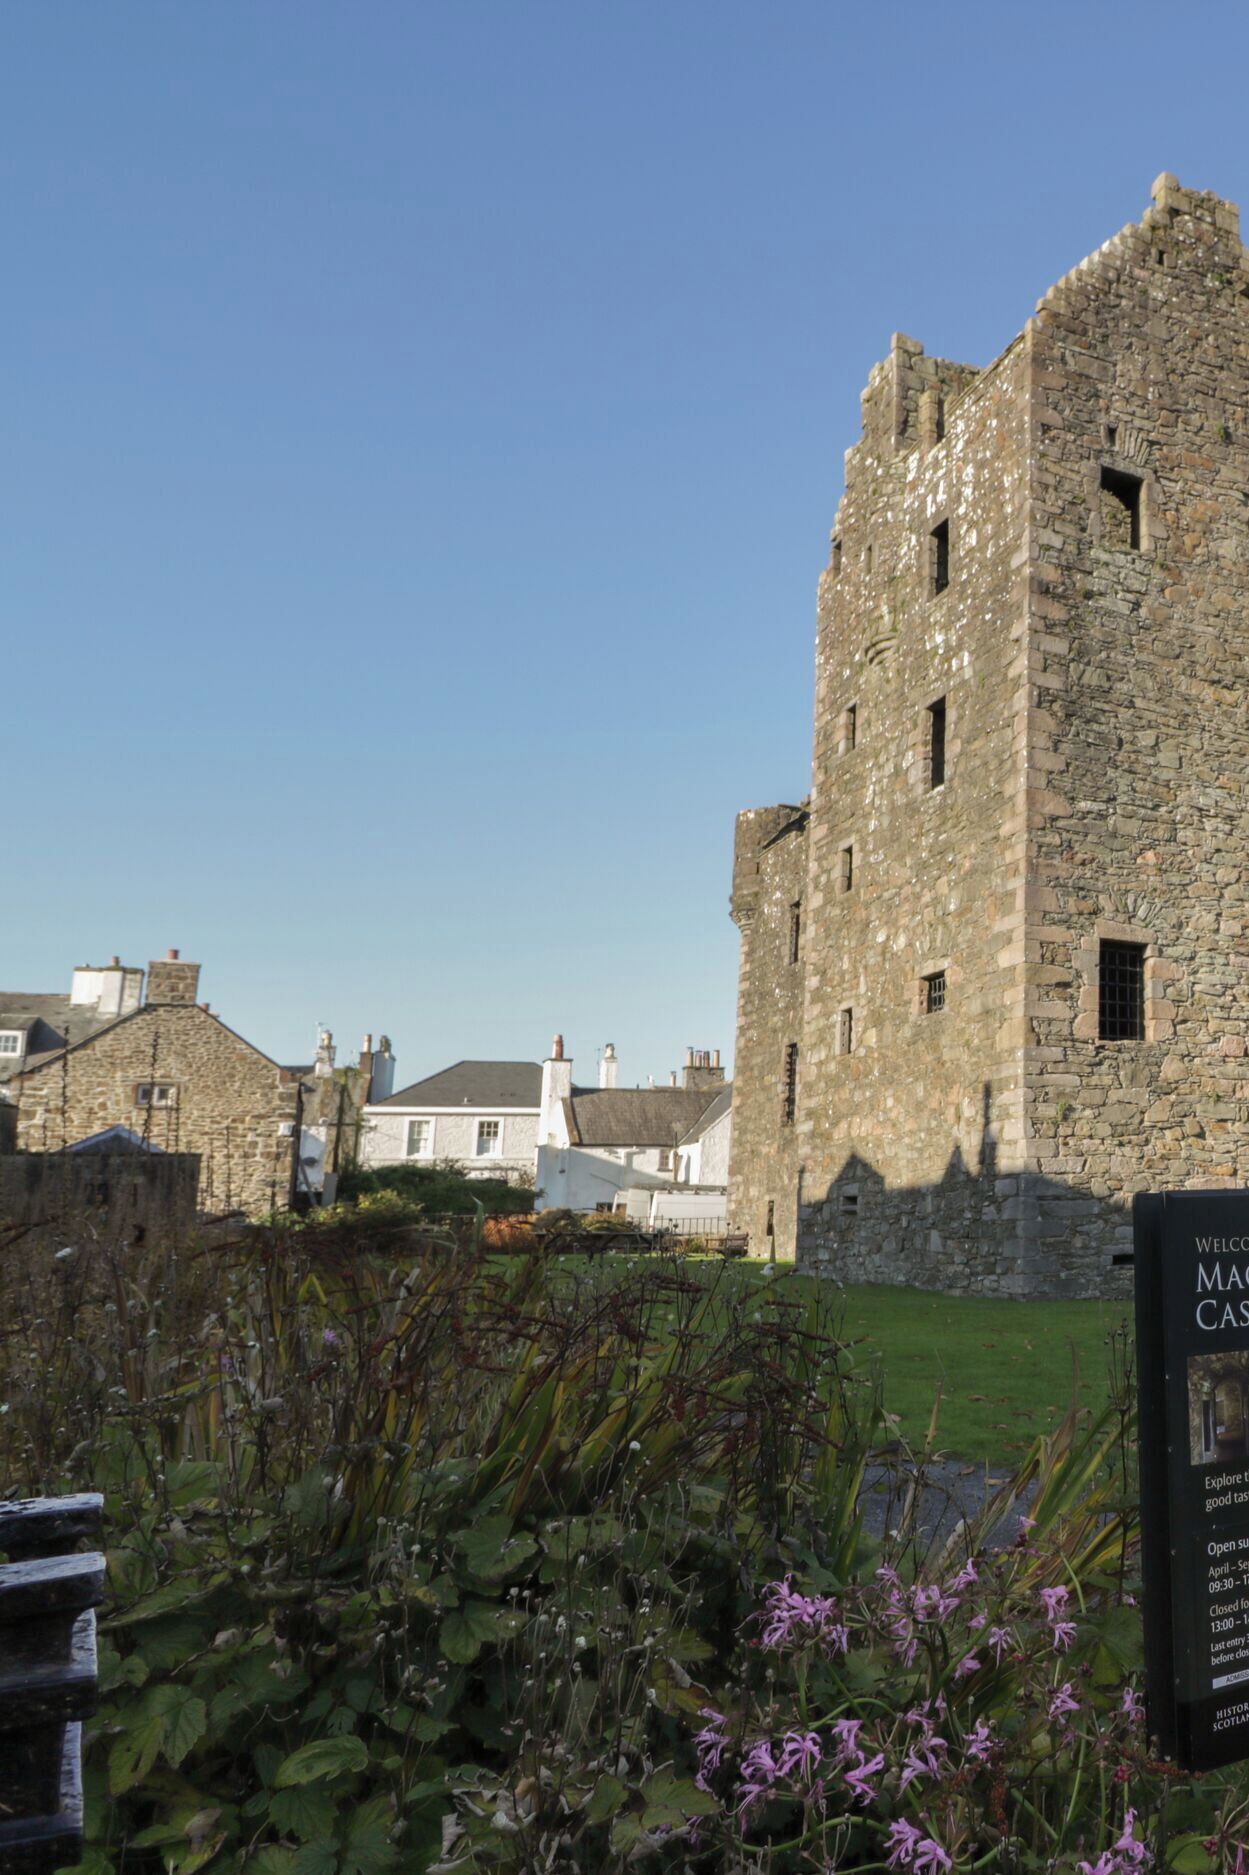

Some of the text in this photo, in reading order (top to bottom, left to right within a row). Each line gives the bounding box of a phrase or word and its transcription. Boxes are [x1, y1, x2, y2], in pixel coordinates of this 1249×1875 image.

[1205, 1472, 1242, 1491] Explore
[1205, 1492, 1232, 1512] good
[1207, 1540, 1236, 1557] Open
[1208, 1562, 1229, 1579] April
[1208, 1577, 1234, 1593] 09:30
[1209, 1599, 1239, 1617] Closed
[1211, 1617, 1234, 1633] 13:00
[1210, 1641, 1225, 1652] Last
[1226, 1636, 1246, 1646] entry
[1211, 1653, 1235, 1666] before
